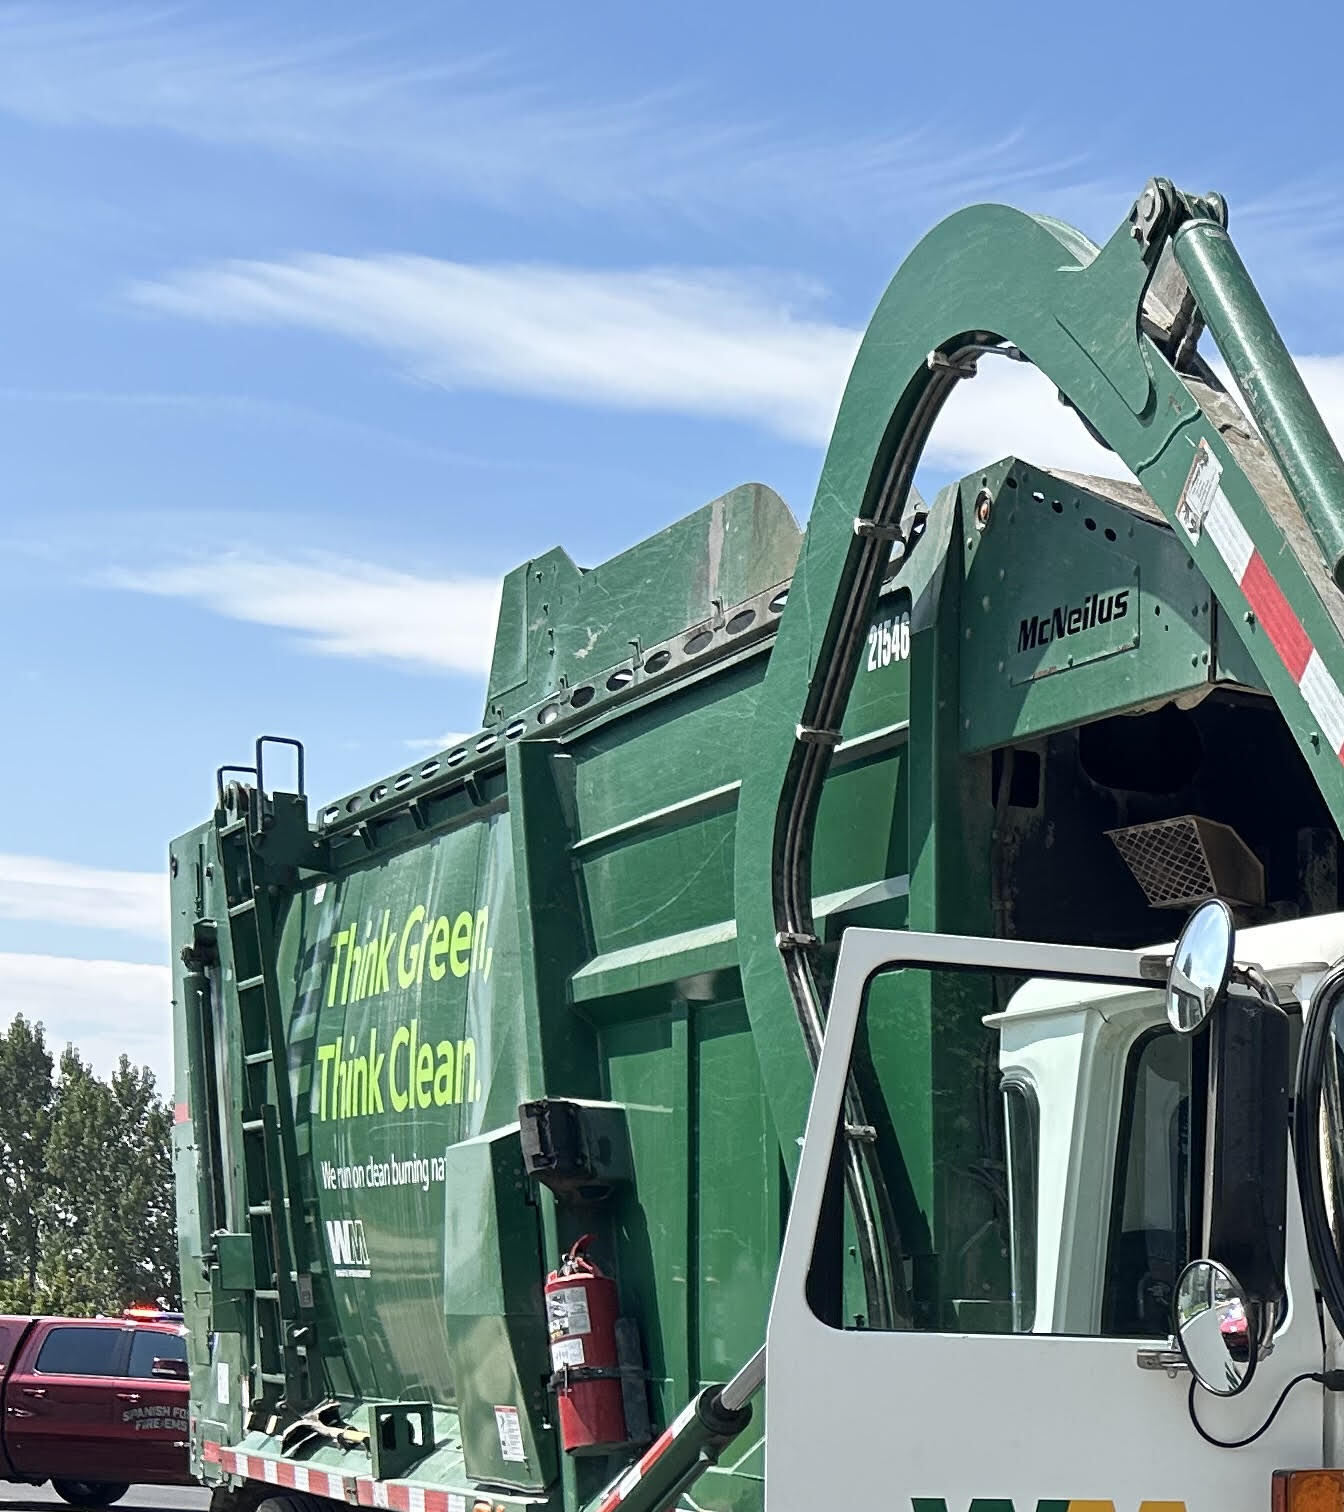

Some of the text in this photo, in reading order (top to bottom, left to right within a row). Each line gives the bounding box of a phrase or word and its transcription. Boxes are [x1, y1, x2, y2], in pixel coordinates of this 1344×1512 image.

[867, 611, 911, 672] 21546
[1017, 590, 1130, 653] McNeilus
[327, 904, 493, 1008] Think Green,
[317, 1018, 482, 1122] Think Clean.
[320, 1160, 337, 1190] We
[337, 1166, 353, 1189] run
[353, 1165, 366, 1189] on
[366, 1155, 391, 1188] clean
[391, 1153, 430, 1192] burning
[326, 1219, 371, 1265] WM
[122, 1405, 170, 1422] SPANISH
[135, 1418, 161, 1431] FIRE
